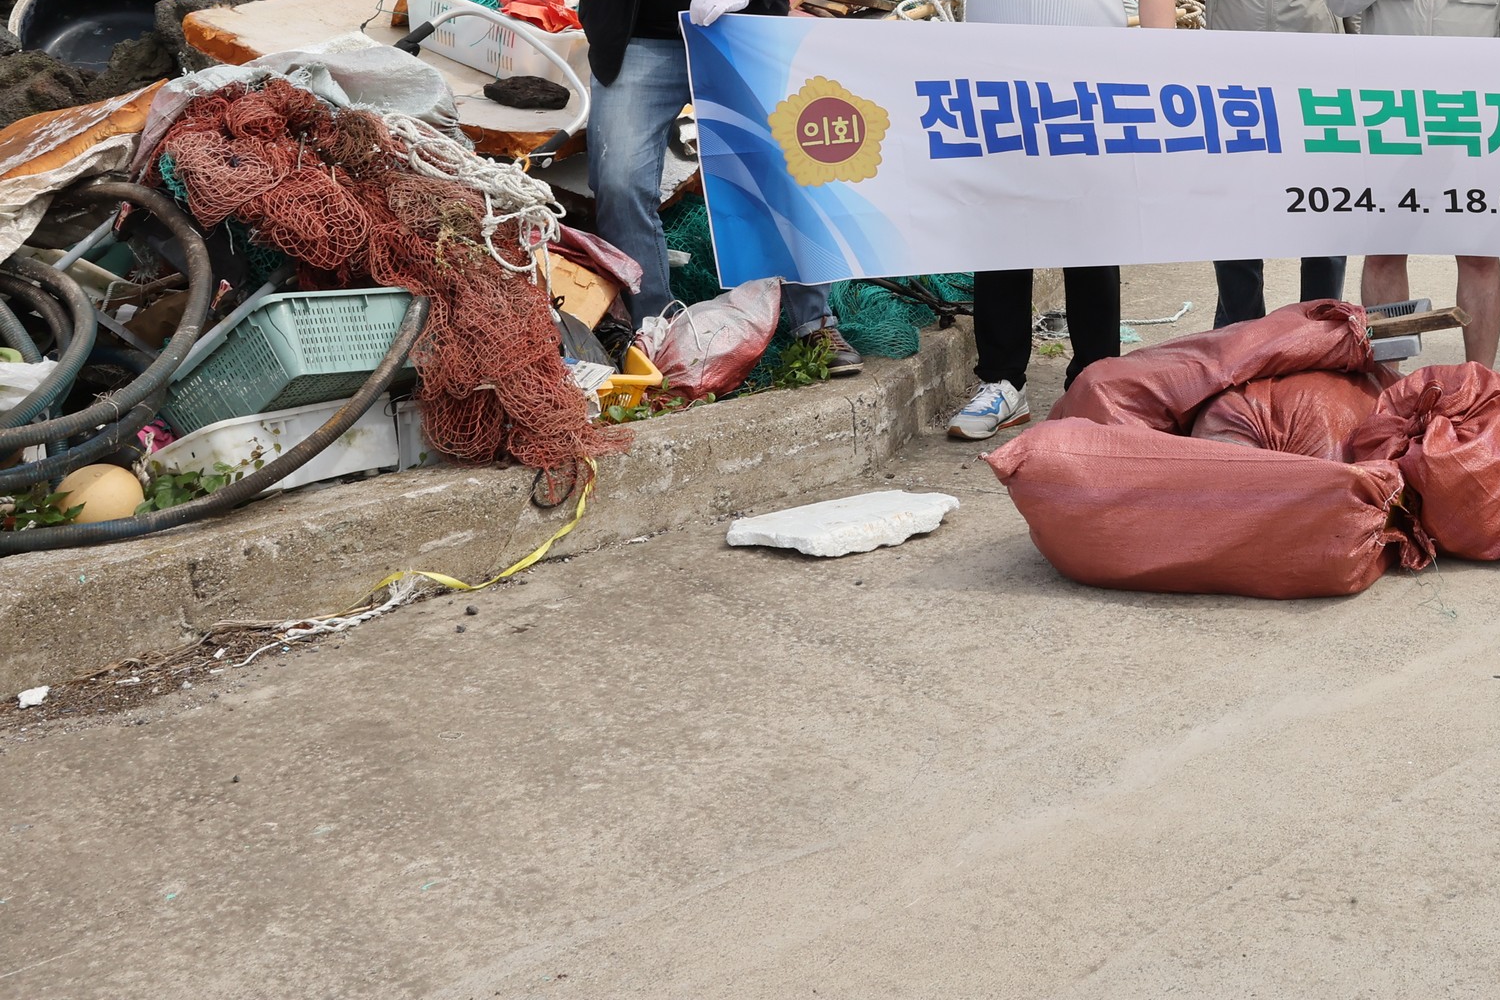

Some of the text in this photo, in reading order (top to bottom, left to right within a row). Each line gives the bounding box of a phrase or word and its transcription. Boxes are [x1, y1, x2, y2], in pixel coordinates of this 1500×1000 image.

[801, 114, 860, 147] 의회
[916, 79, 1282, 160] 전라남도의회
[1285, 187, 1387, 214] 2024.
[1398, 188, 1430, 214] 4.
